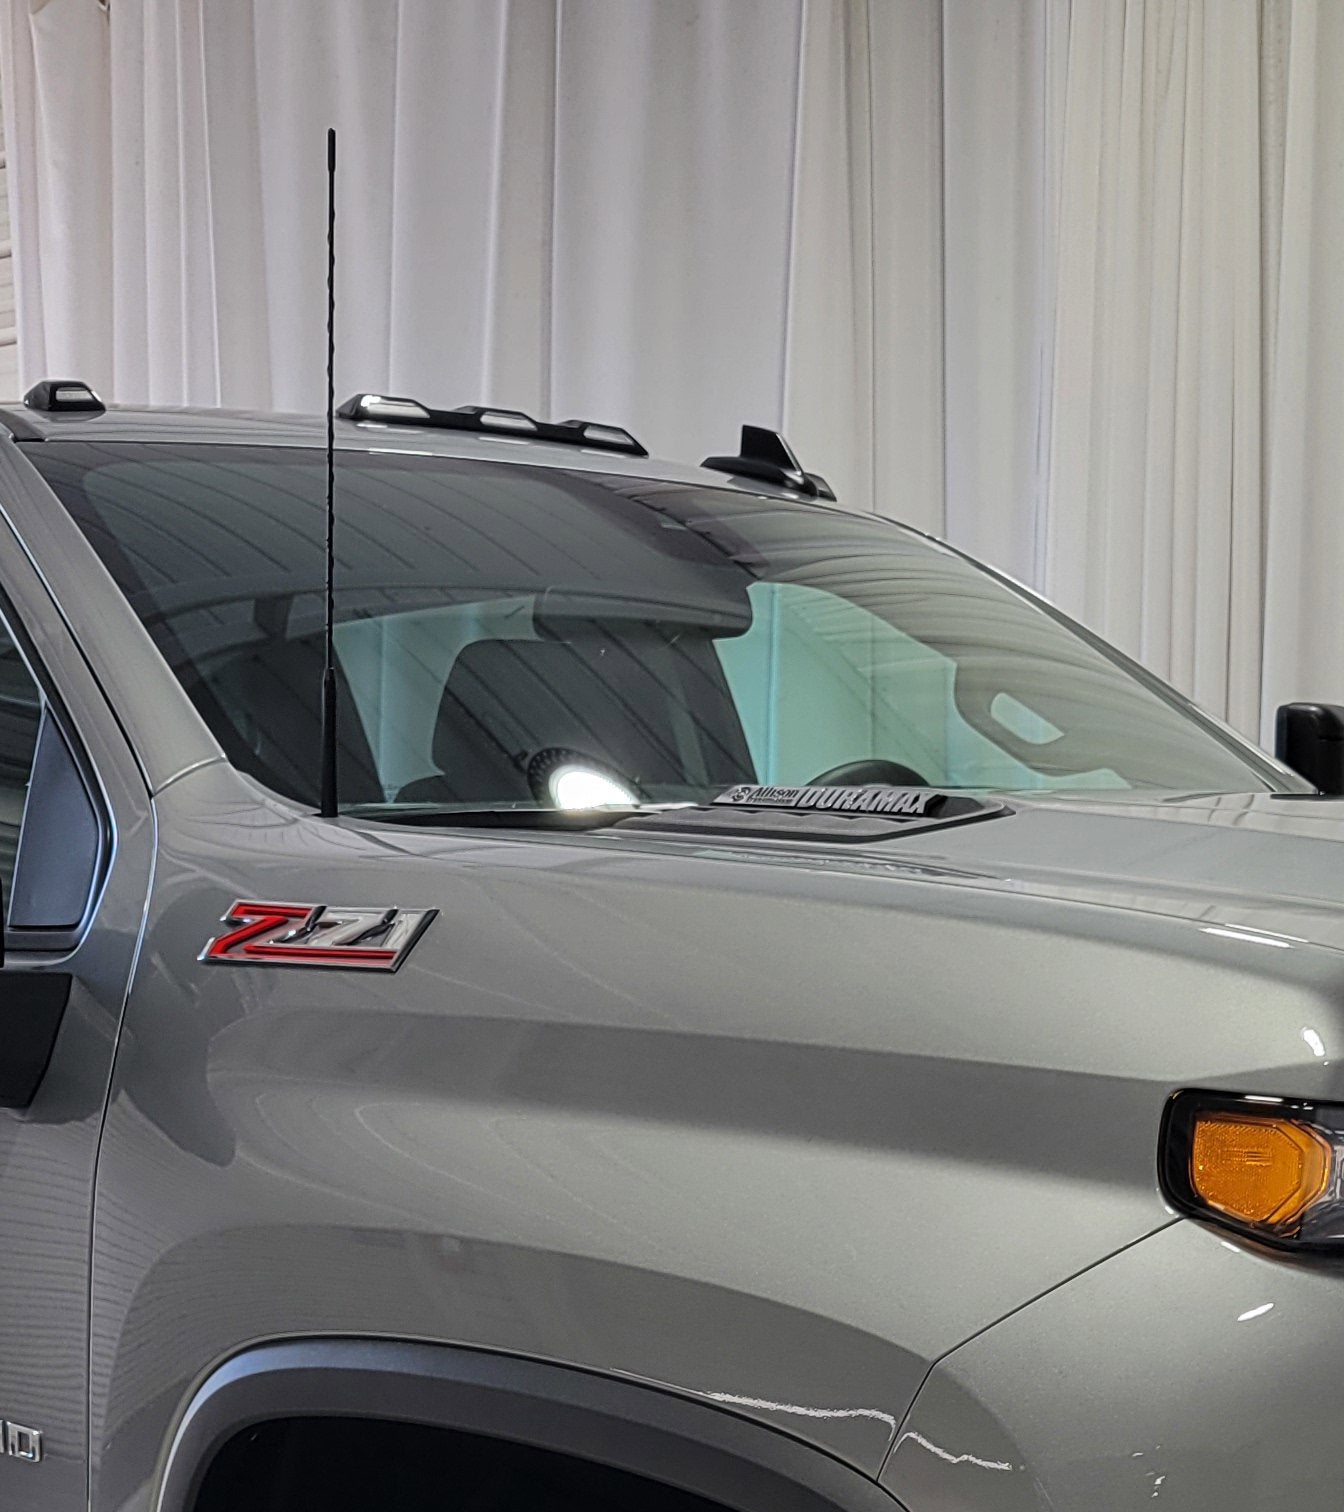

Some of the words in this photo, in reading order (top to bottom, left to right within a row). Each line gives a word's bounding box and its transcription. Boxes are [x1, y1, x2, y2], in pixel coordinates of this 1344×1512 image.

[750, 786, 799, 799] Allison
[796, 787, 934, 814] DURAMAX
[196, 899, 440, 974] Z71
